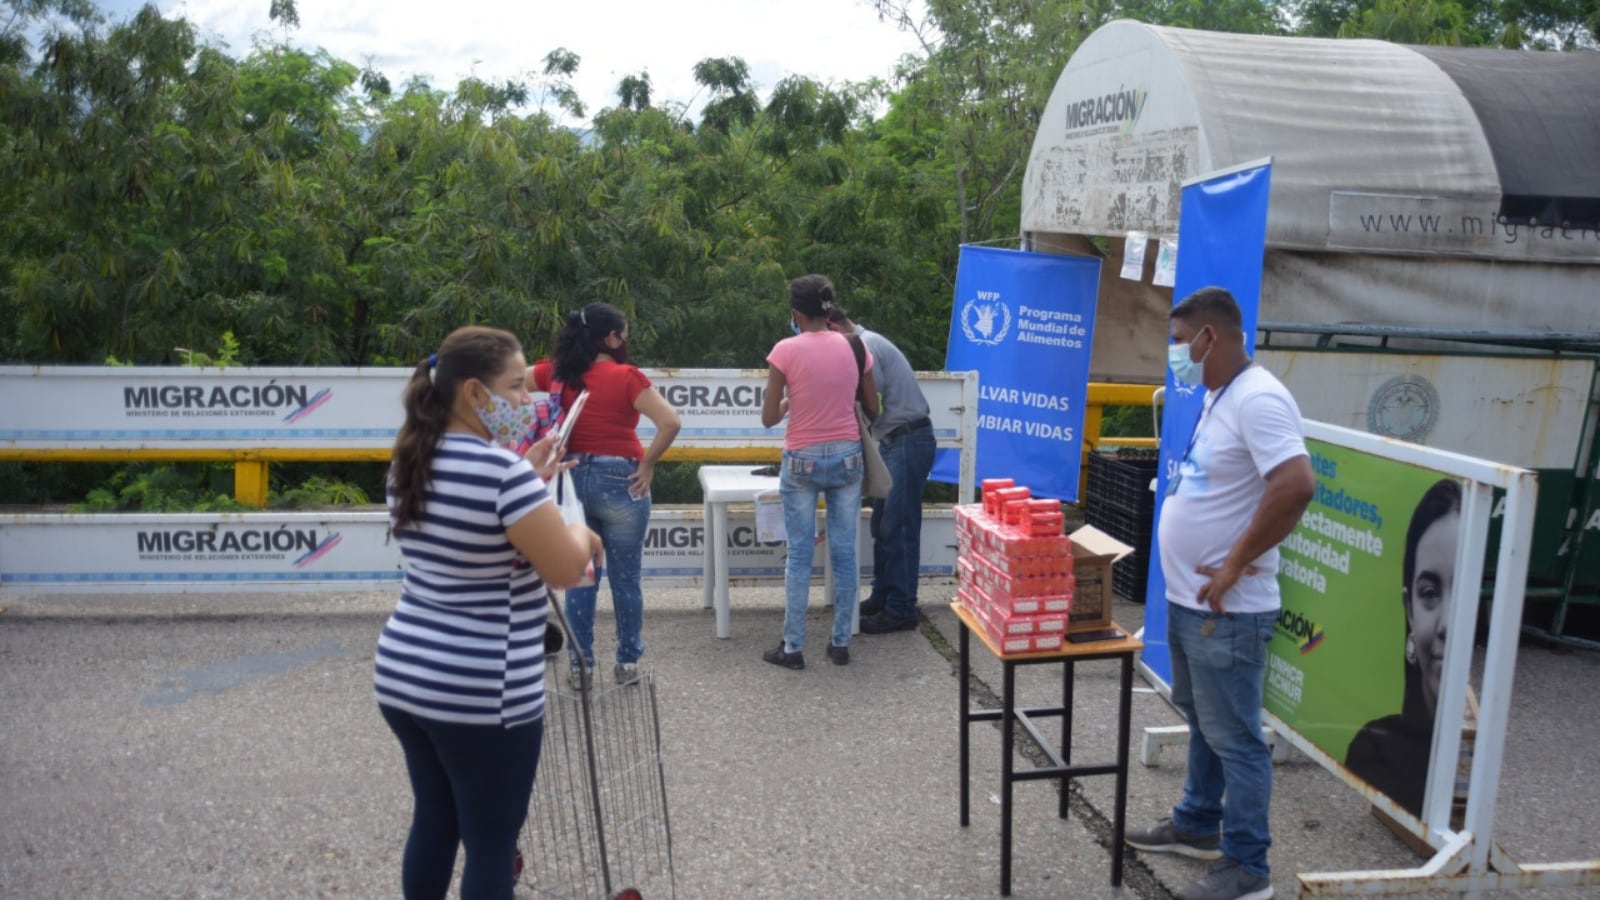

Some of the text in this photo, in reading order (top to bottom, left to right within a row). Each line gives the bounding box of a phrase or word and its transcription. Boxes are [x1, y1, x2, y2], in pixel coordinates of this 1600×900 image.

[1065, 83, 1136, 129] MIGRACIÓN
[977, 290, 1000, 301] WFP
[1019, 305, 1082, 322] Programa
[1018, 319, 1086, 336] Mundial de
[1017, 331, 1082, 348] Alimentos
[124, 380, 307, 408] MIGRACIÓN
[978, 384, 1069, 411] LVAR VIDAS
[1025, 421, 1073, 441] VIDAS
[137, 524, 316, 552] MIGRACIÓN
[1268, 669, 1302, 703] ACNUR
